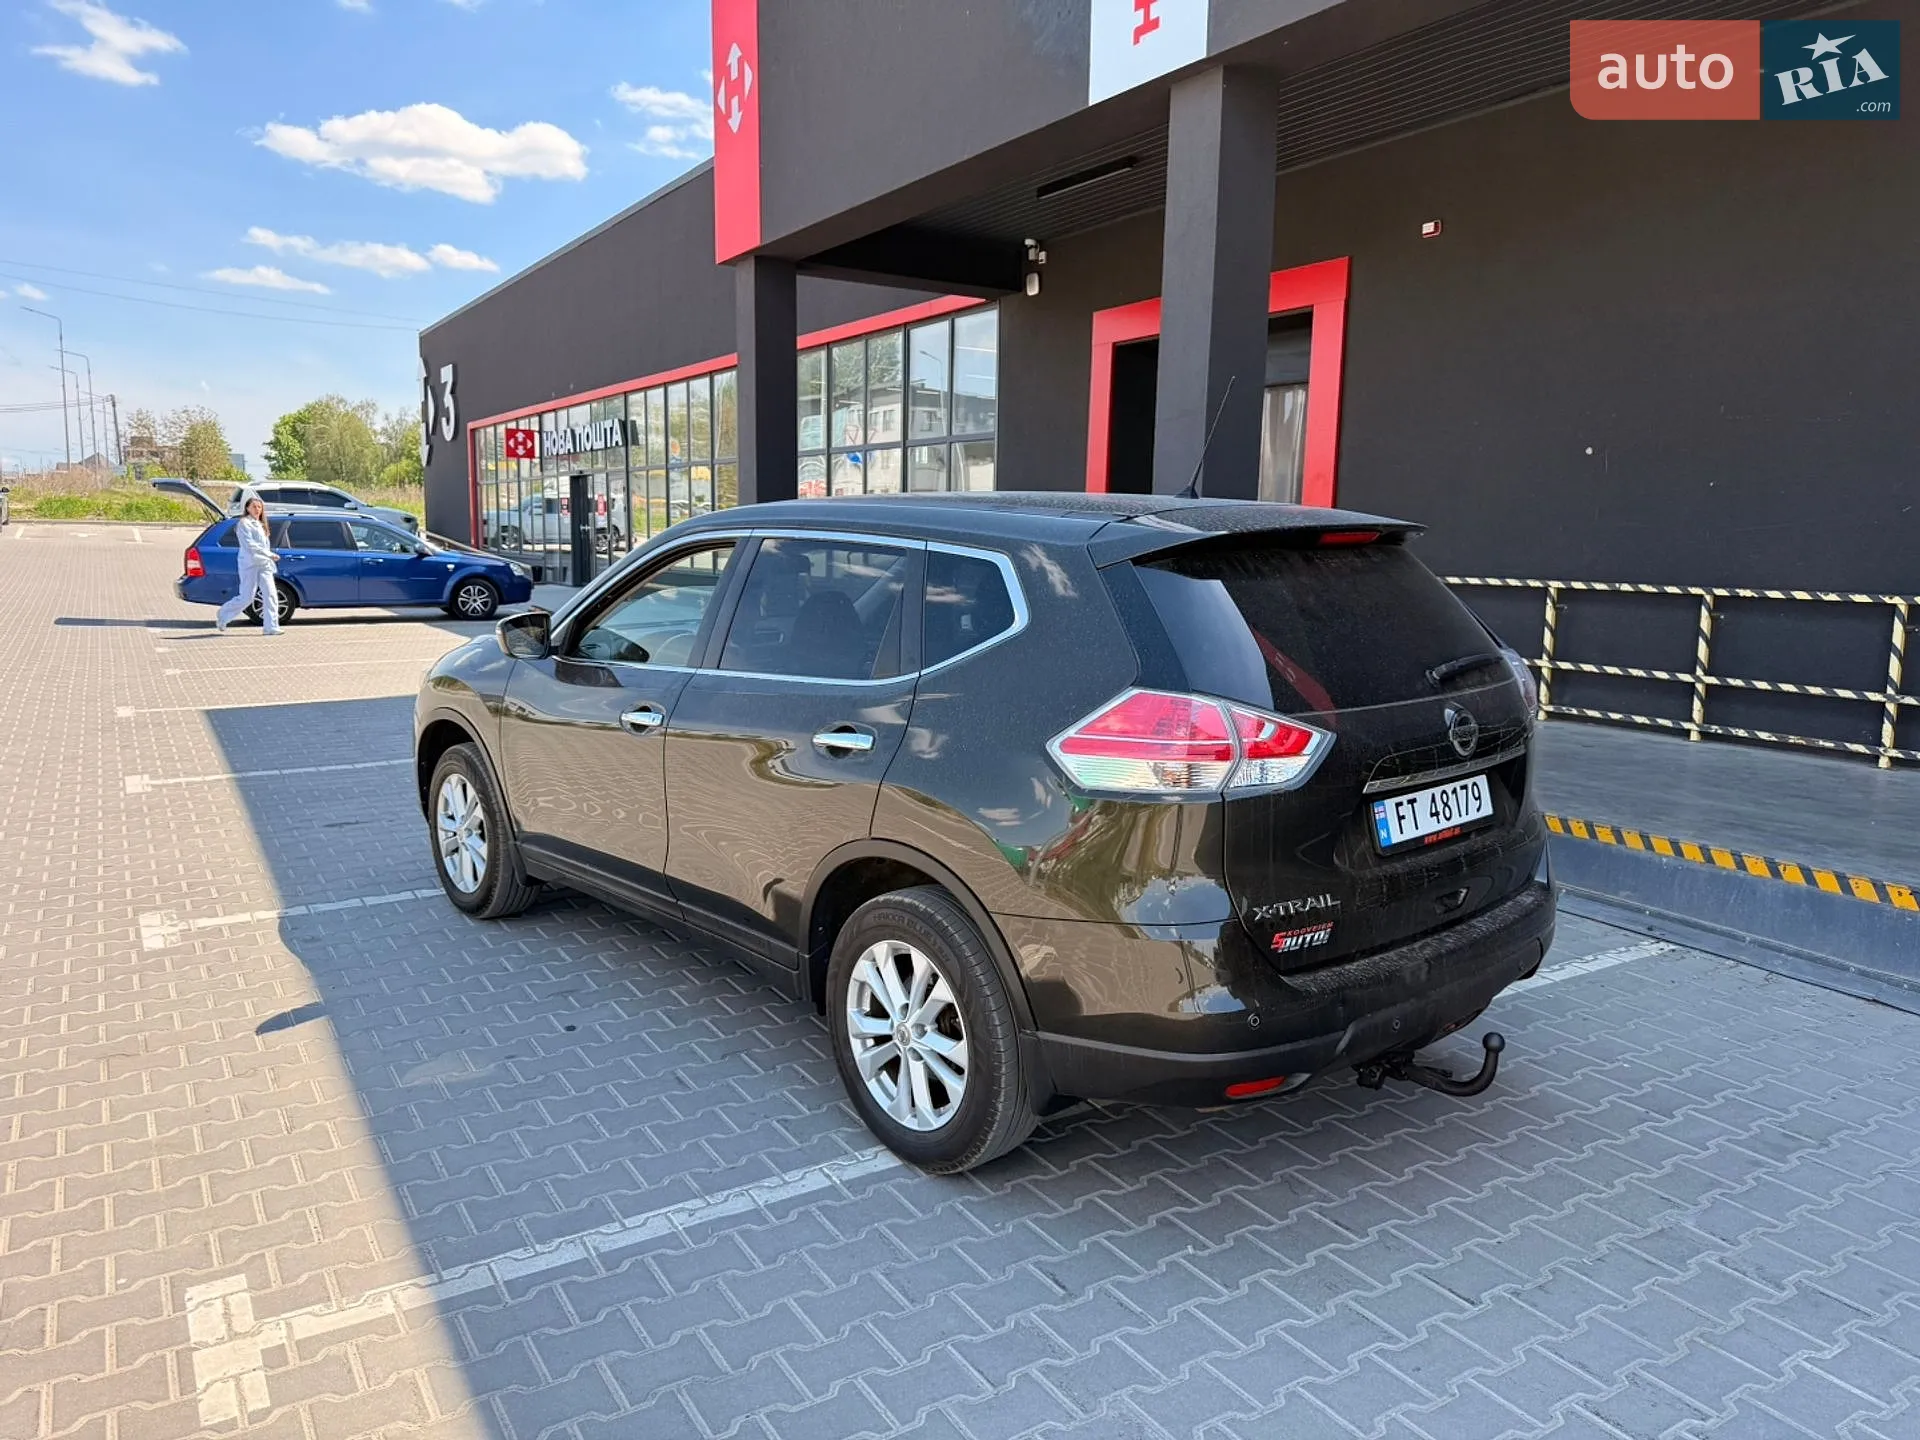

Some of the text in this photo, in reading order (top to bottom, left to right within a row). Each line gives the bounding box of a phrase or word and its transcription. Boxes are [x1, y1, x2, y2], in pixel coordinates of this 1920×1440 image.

[440, 363, 456, 442] 3
[543, 418, 623, 457] НОВА ПОШТА
[1394, 781, 1483, 835] FT 48179
